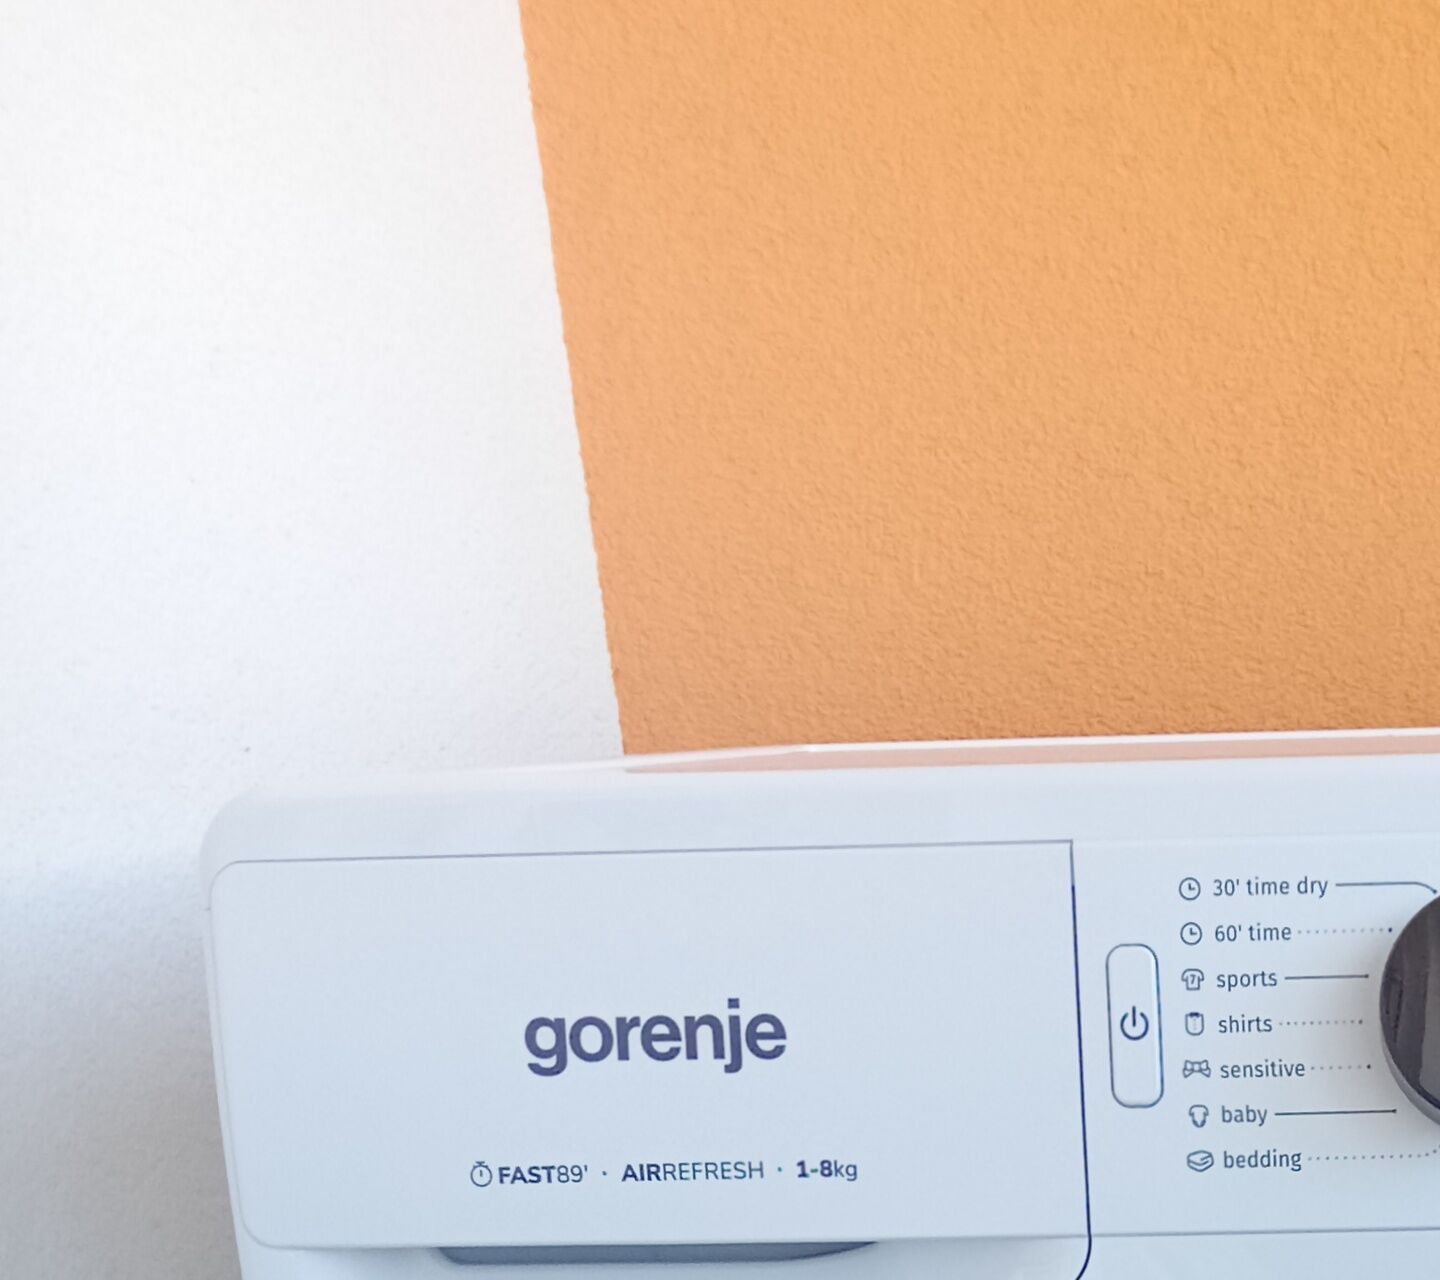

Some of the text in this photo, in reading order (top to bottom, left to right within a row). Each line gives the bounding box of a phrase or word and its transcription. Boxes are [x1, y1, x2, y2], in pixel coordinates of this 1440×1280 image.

[1213, 876, 1329, 898] 30' time dry
[1215, 923, 1292, 943] 60' time
[1216, 970, 1278, 992] sports
[1218, 1015, 1273, 1034] shirts
[524, 998, 788, 1077] gorenje
[1220, 1060, 1306, 1079] sensitive
[1221, 1105, 1268, 1128] baby
[1223, 1149, 1302, 1172] bedding
[498, 1159, 858, 1185] FAST89' AIRREFRESH 1-8kg
